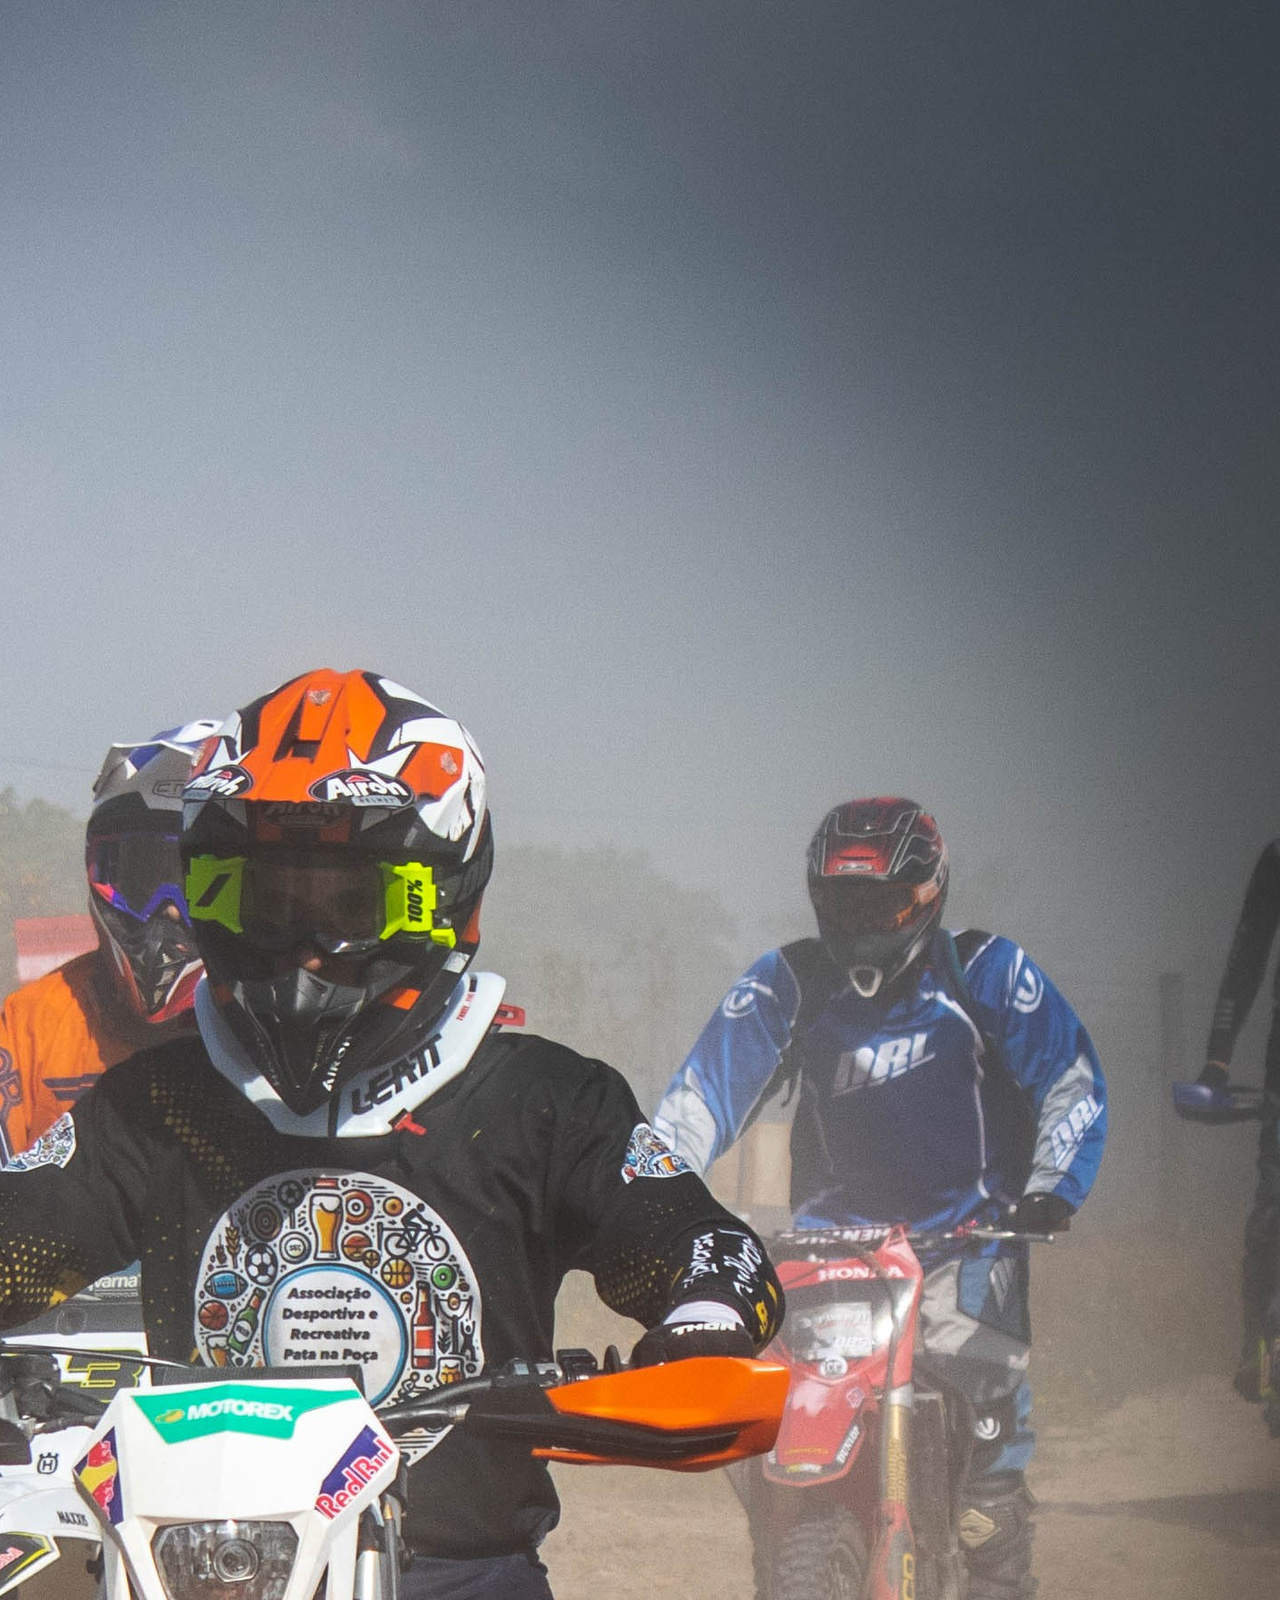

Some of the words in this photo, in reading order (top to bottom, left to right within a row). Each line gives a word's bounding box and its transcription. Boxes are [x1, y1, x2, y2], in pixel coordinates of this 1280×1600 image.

[327, 773, 408, 801] Airoh
[407, 879, 423, 923] 100%
[351, 1033, 442, 1115] LEATT
[818, 1264, 905, 1281] HONA
[287, 1286, 372, 1302] Associação
[282, 1307, 365, 1322] Desportiva
[368, 1310, 378, 1319] e
[290, 1327, 370, 1340] Recreativa
[283, 1348, 317, 1360] Pata
[320, 1350, 339, 1360] na
[342, 1348, 379, 1364] Poça
[187, 1398, 294, 1421] MOTOREX
[57, 1510, 89, 1527] MAXXIS
